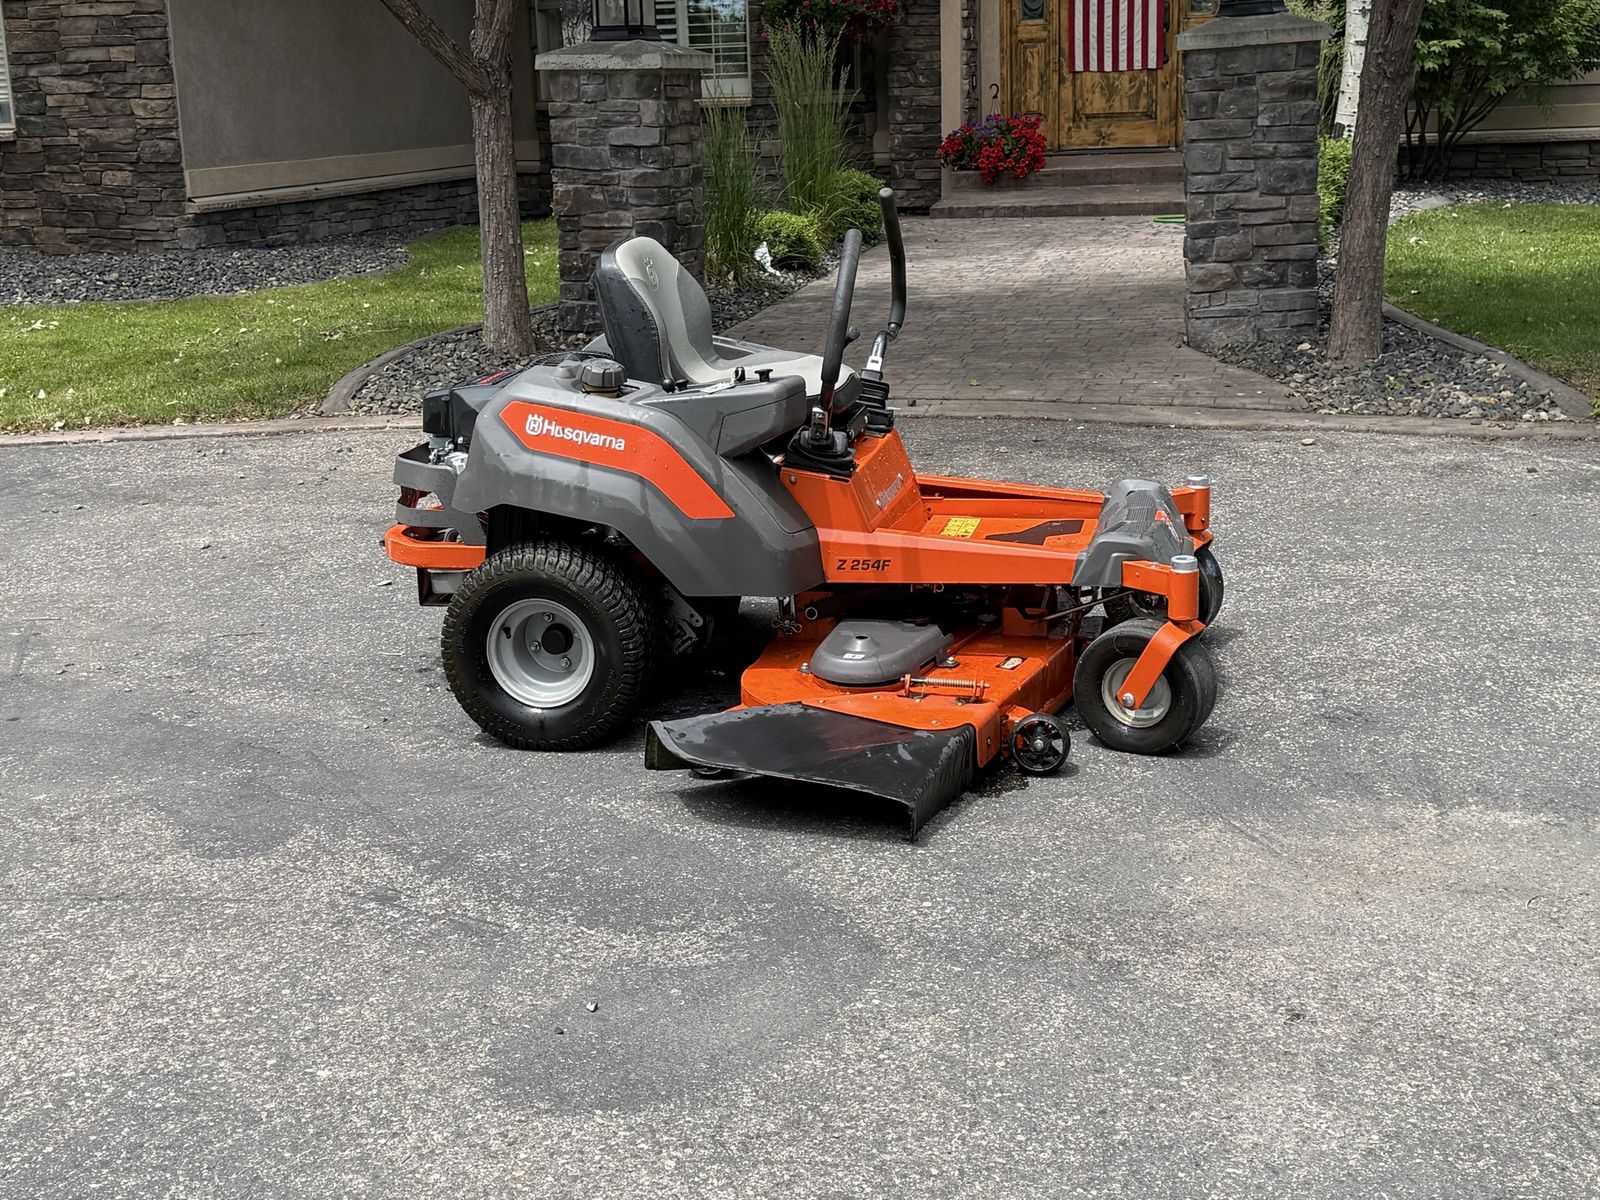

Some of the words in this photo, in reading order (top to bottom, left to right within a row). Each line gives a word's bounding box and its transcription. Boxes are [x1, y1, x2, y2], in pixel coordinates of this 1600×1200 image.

[543, 419, 626, 451] Husqvarna
[836, 559, 848, 571] Z
[850, 559, 892, 571] 254F
